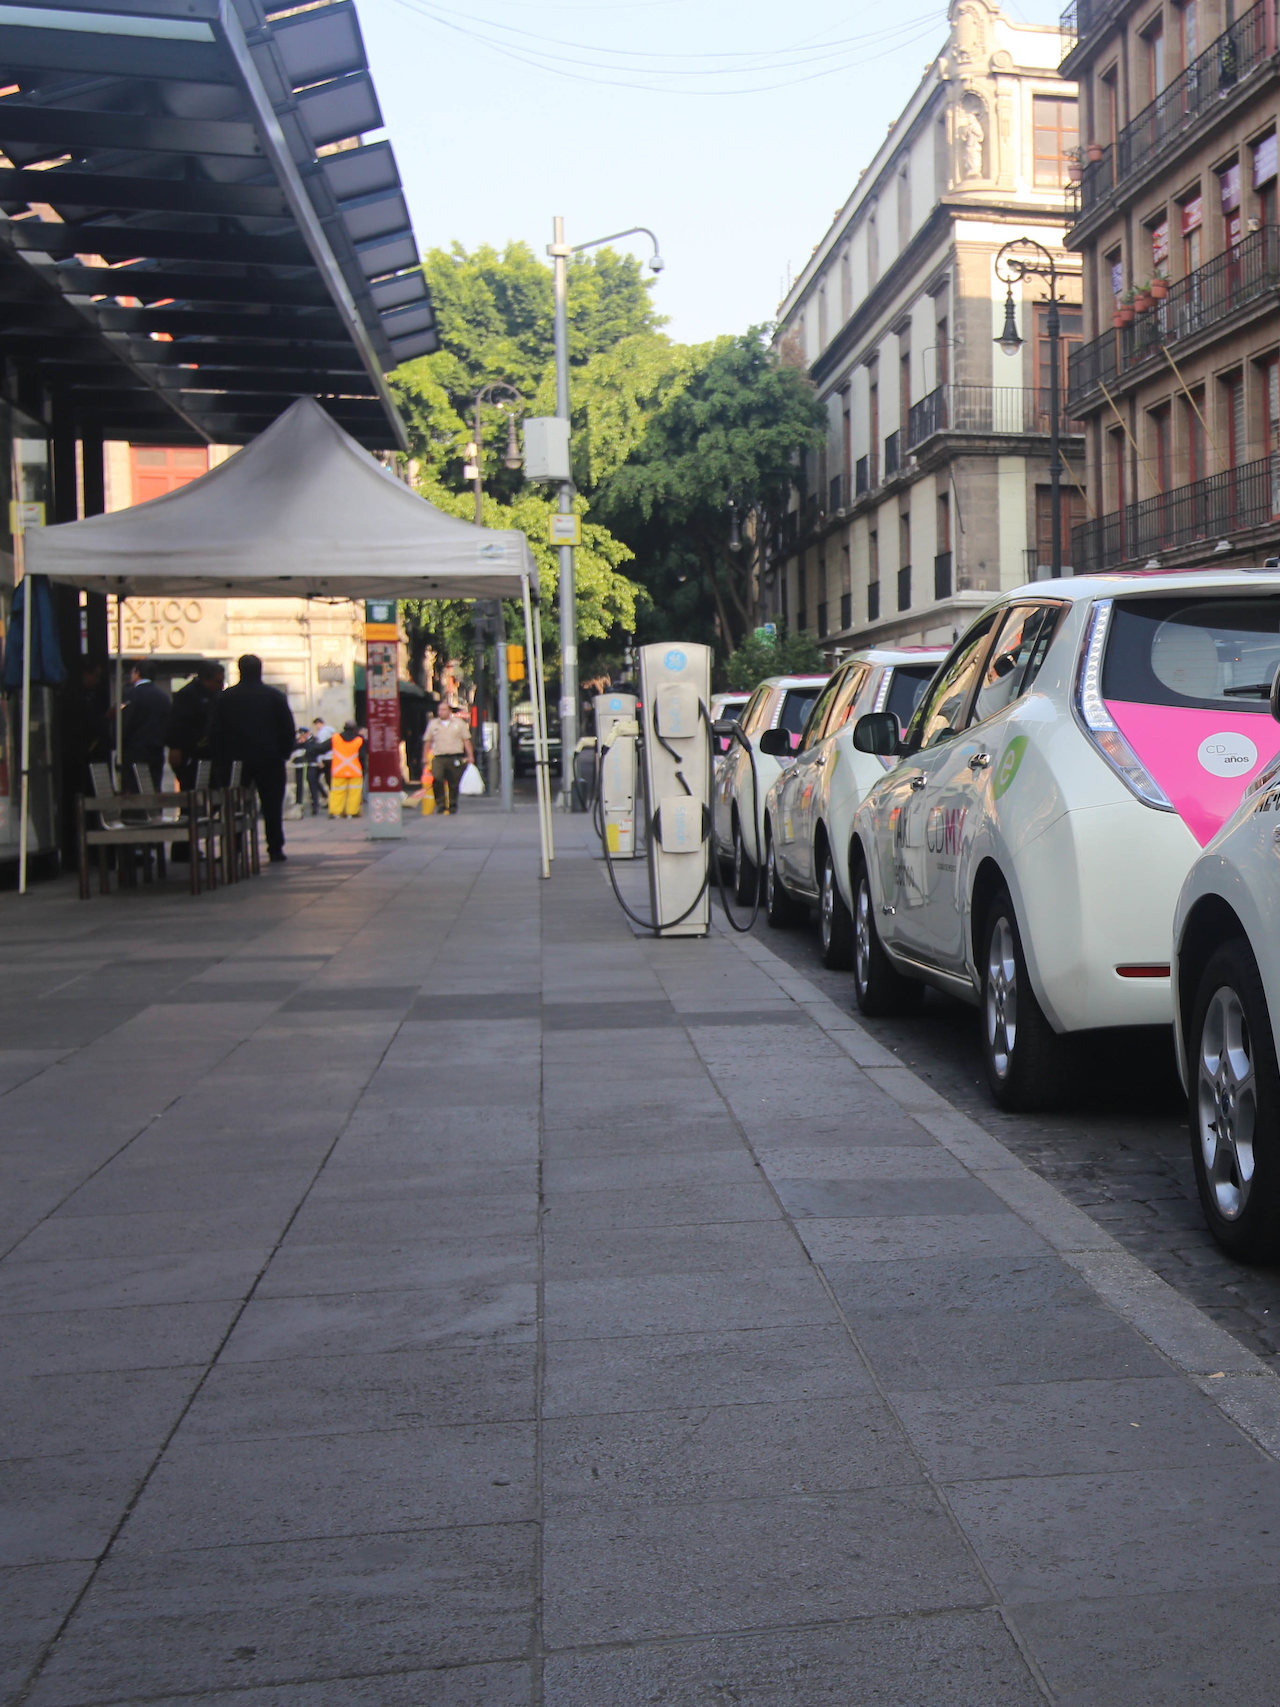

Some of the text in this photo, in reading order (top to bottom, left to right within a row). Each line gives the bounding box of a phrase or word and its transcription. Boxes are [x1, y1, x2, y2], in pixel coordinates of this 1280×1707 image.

[106, 599, 203, 624] EXICO
[111, 625, 188, 650] IEJO
[1224, 755, 1250, 764] años
